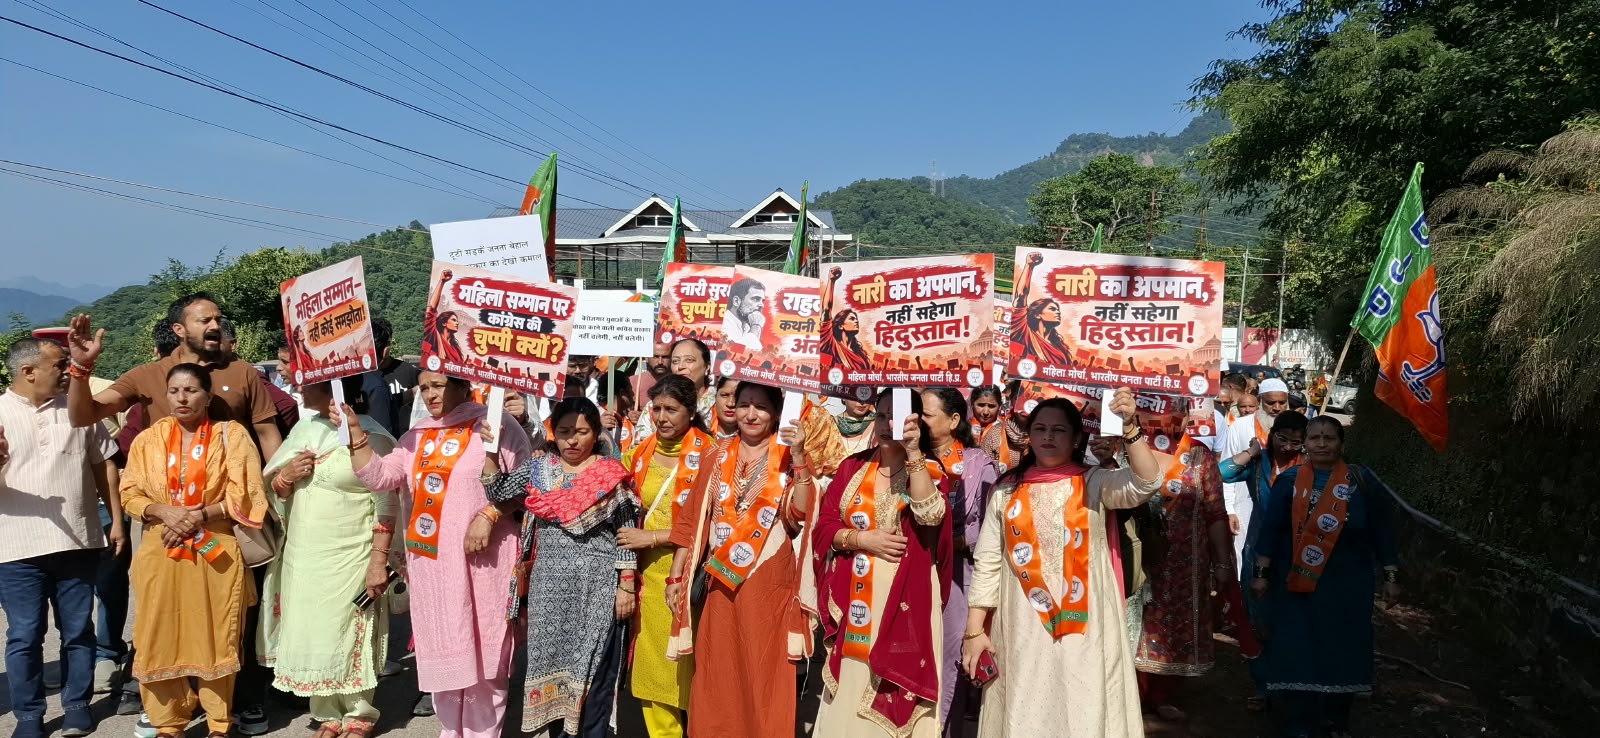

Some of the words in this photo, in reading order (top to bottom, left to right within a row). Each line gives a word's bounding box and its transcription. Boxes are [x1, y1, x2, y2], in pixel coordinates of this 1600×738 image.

[487, 244, 506, 253] जनता
[509, 240, 529, 251] बेहाल
[501, 257, 517, 266] देखो
[519, 254, 542, 263] कमाल
[680, 278, 708, 297] नारी
[708, 283, 732, 301] सुर
[852, 275, 886, 305] नारी
[889, 278, 913, 301] का
[916, 271, 981, 298] अपमान,
[1055, 267, 1098, 297] नारी
[1100, 275, 1129, 298] का
[1132, 276, 1209, 303] अपमान,
[295, 291, 323, 320] महिला
[459, 280, 505, 308] महिला
[505, 290, 551, 315] सम्मान
[551, 297, 571, 317] पर
[487, 310, 526, 330] कांग्रेस
[526, 316, 542, 332] की
[681, 298, 717, 324] चुप्पी
[886, 304, 914, 324] नहीं
[916, 301, 956, 320] सहेगा
[1095, 302, 1130, 322] नहीं
[1131, 302, 1180, 322] सहेगा
[309, 321, 319, 343] नहीं
[320, 314, 334, 336] कोई
[334, 304, 366, 329] समझौता!
[779, 318, 816, 333] कथनी
[874, 316, 970, 351] हिंदुस्तान!
[1079, 314, 1195, 350] हिंदुस्तान!
[473, 327, 514, 356] चुप्पी
[515, 334, 564, 363] क्यों?
[444, 362, 461, 372] महिला
[498, 373, 513, 384] जनता
[513, 377, 526, 388] पार्टी
[740, 367, 760, 377] महिला
[760, 369, 776, 381] मोर्चा,
[779, 373, 801, 385] भारतीय
[802, 378, 820, 389] जनता
[848, 372, 866, 383] महिला
[868, 372, 884, 383] मोर्चा,
[886, 372, 908, 382] भारतीय
[910, 373, 928, 382] जनता
[929, 372, 944, 382] पार्टी
[1042, 366, 1065, 378] महिला
[1068, 367, 1088, 380] मोर्चा,
[1091, 371, 1118, 383] भारतीय
[1121, 376, 1142, 385] जनता
[1144, 376, 1161, 387] पार्टी
[1136, 395, 1167, 414] करो!
[425, 497, 433, 507] P
[751, 528, 762, 540] P
[855, 581, 864, 593] P
